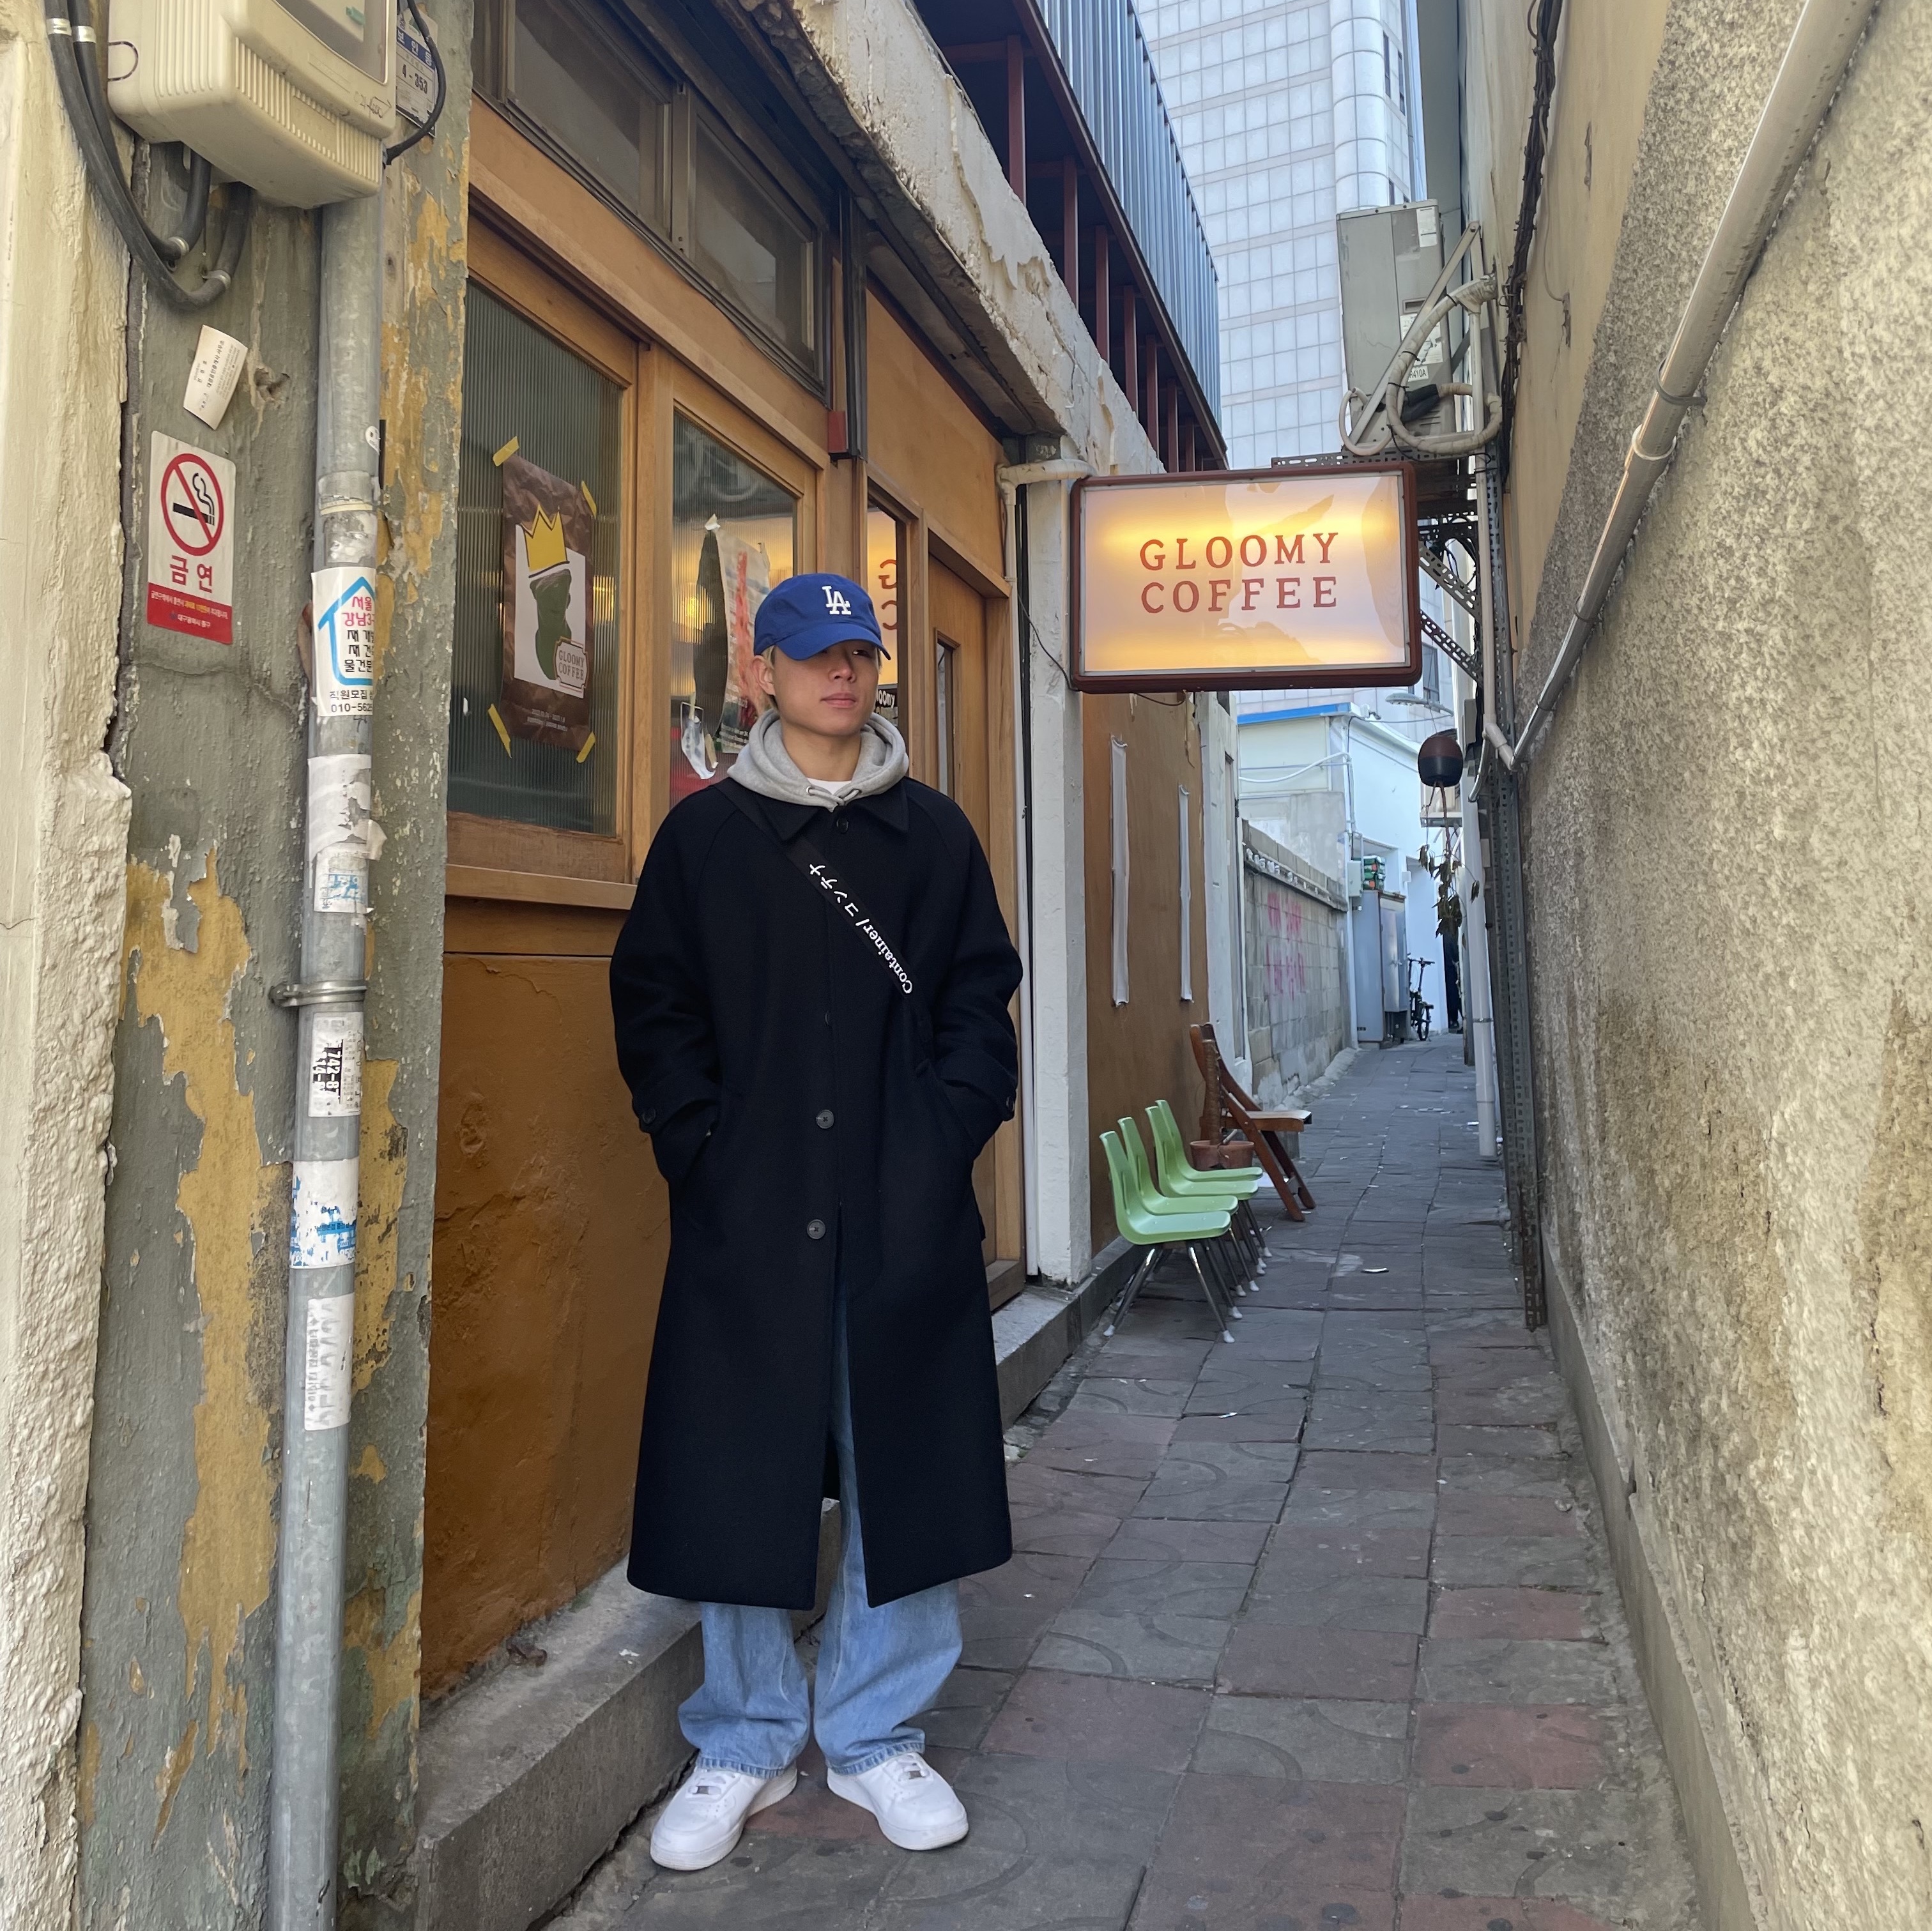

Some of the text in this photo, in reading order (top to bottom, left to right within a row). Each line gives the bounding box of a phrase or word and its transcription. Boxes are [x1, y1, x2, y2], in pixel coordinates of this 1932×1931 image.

[1140, 532, 1338, 570] GLOOMY
[352, 596, 372, 611] 서울
[822, 585, 852, 615] LA
[1141, 576, 1337, 613] COFFEE
[558, 650, 585, 668] GLOOMY
[558, 662, 584, 680] COFFEE
[330, 689, 367, 701] 직원모집
[809, 864, 859, 917] コンテナ
